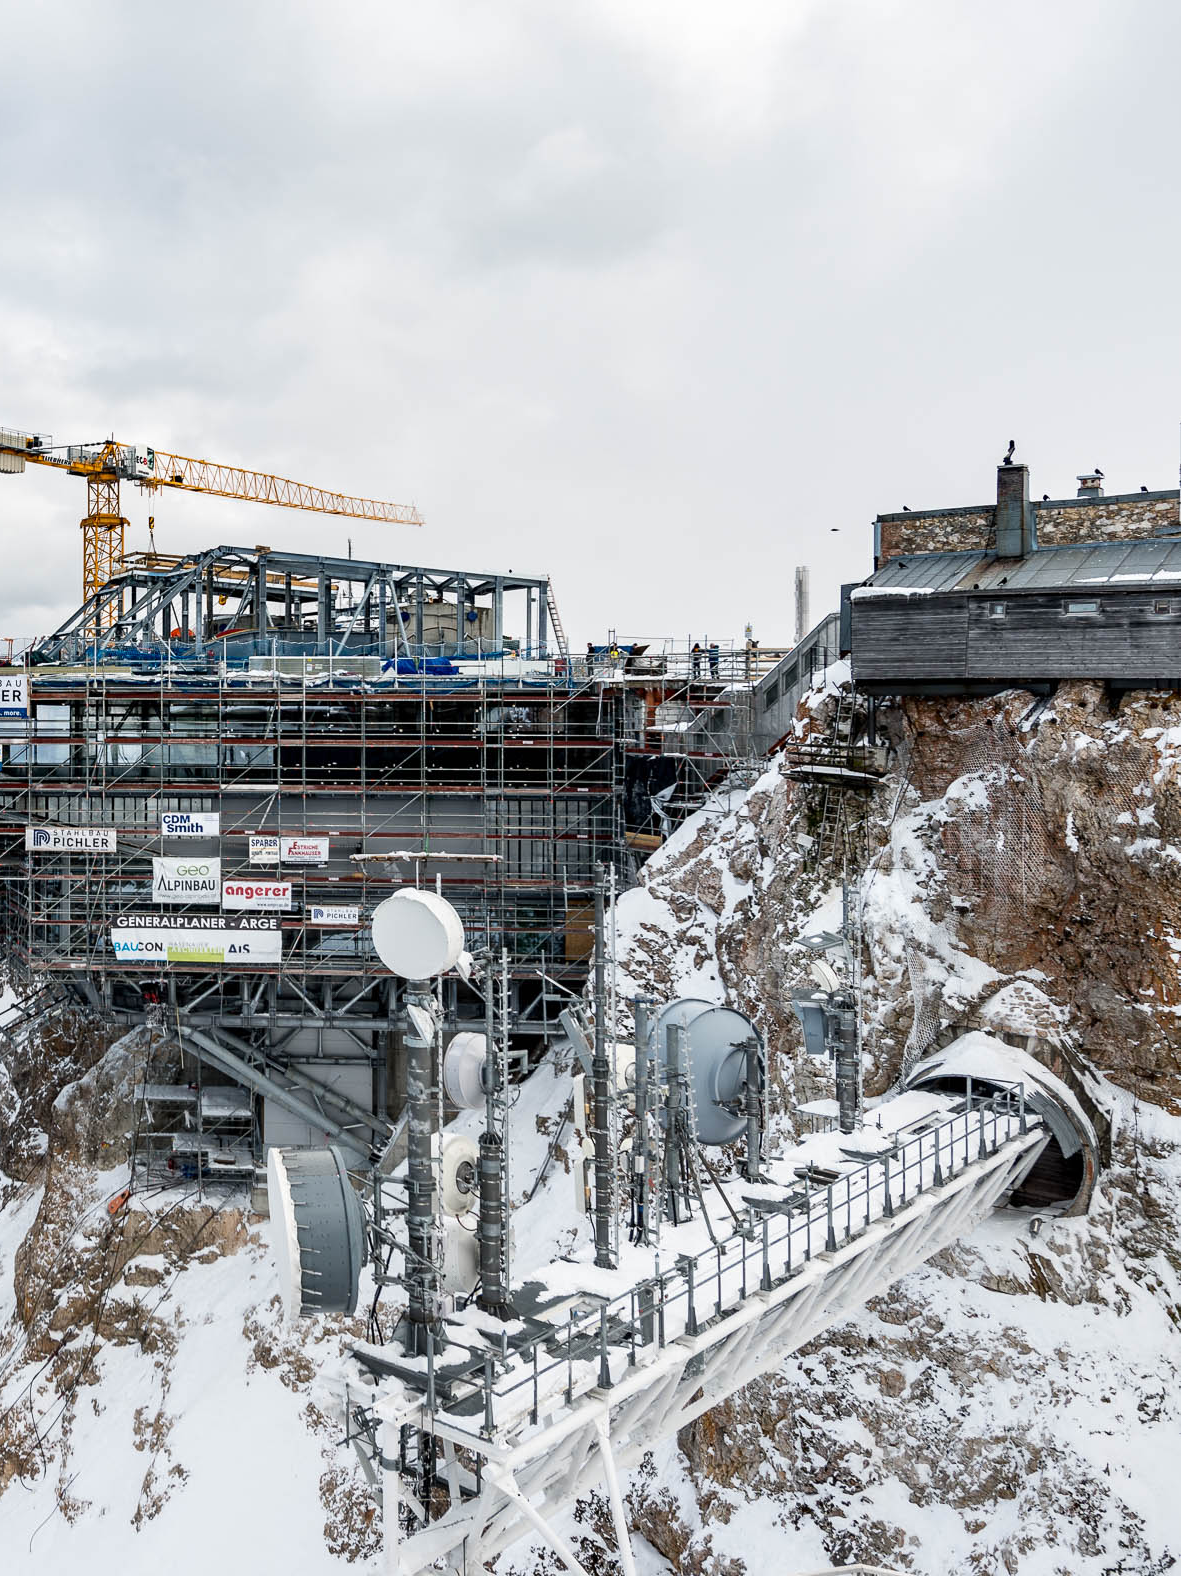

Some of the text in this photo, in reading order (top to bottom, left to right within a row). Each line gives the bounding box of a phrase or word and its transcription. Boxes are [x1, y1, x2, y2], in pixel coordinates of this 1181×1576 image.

[163, 814, 191, 824] CDM
[167, 822, 204, 833] Smith
[53, 829, 109, 837] STAHLBAU
[53, 838, 109, 848] PICHLER
[251, 839, 278, 847] SPARER
[158, 875, 216, 891] ALPINBAU
[225, 886, 289, 900] angerer
[116, 916, 226, 929] GENERALPLANER
[239, 918, 277, 929] ARGE
